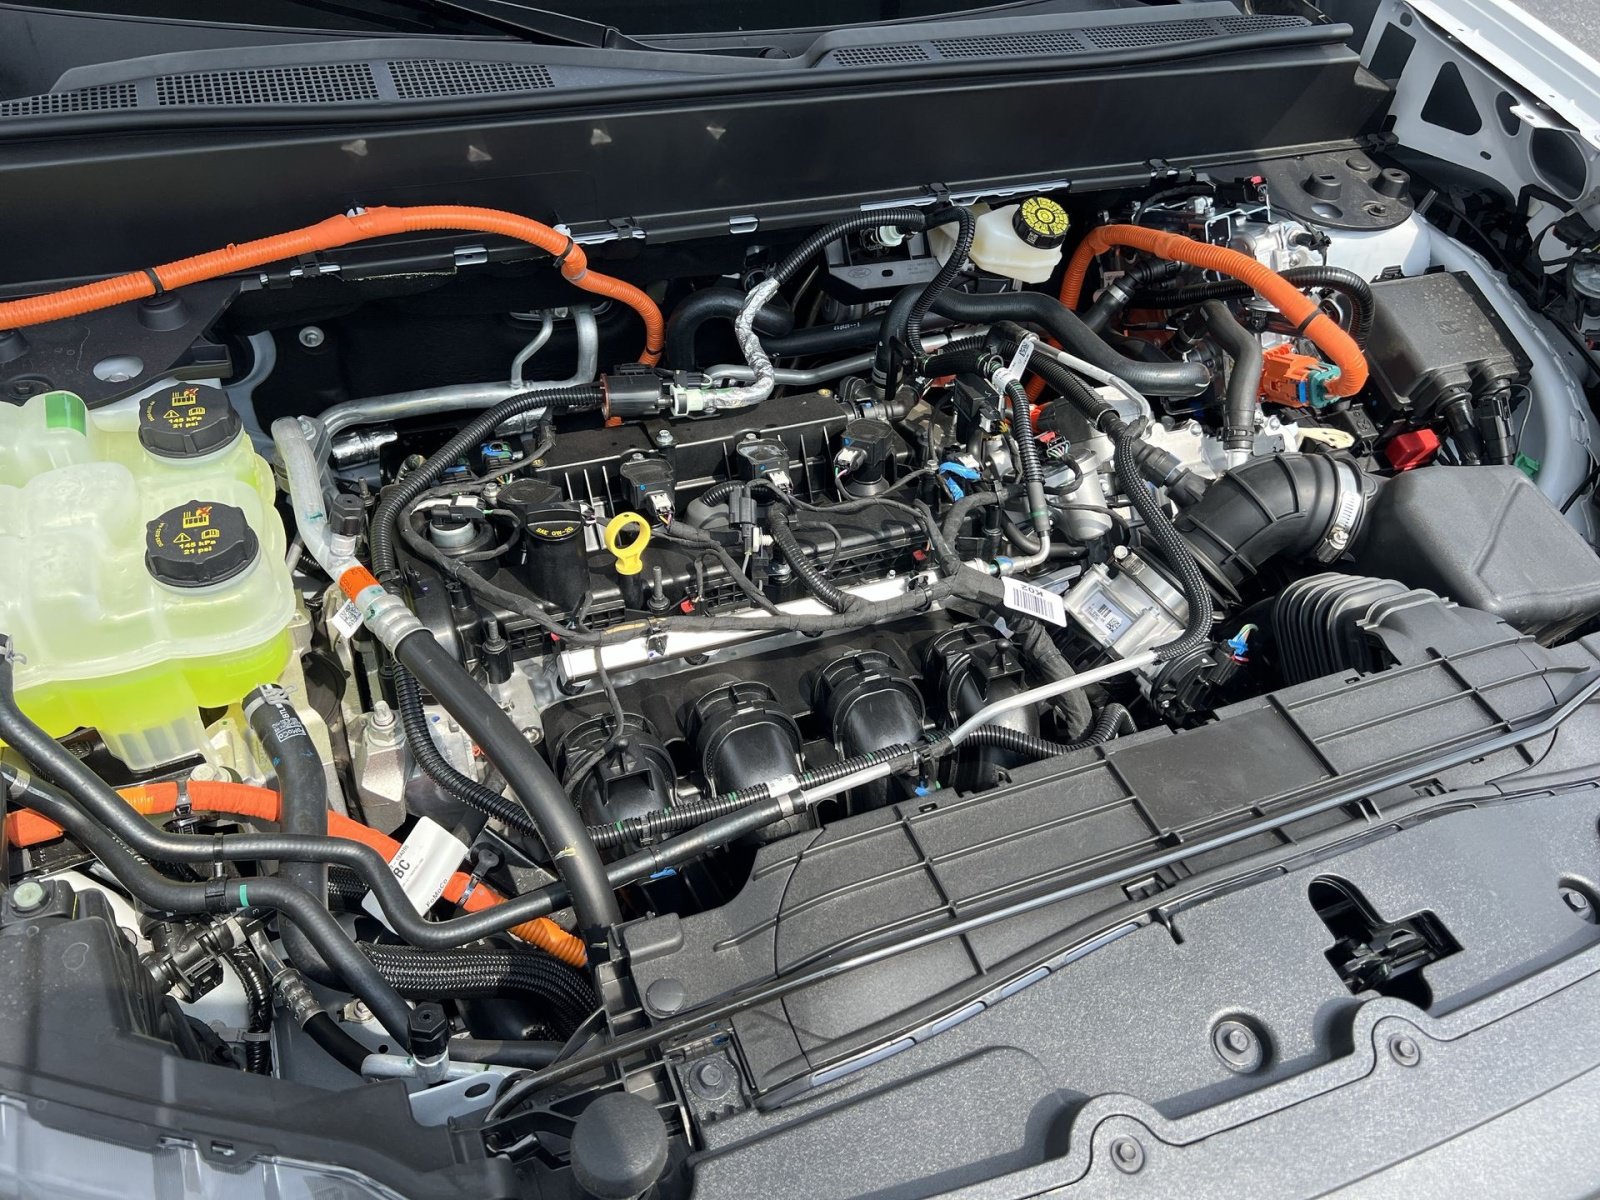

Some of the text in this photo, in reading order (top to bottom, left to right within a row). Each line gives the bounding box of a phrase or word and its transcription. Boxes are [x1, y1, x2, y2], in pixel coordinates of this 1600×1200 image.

[535, 527, 549, 536] SAE
[198, 546, 212, 554] psi
[426, 878, 448, 908] FoMoCo
